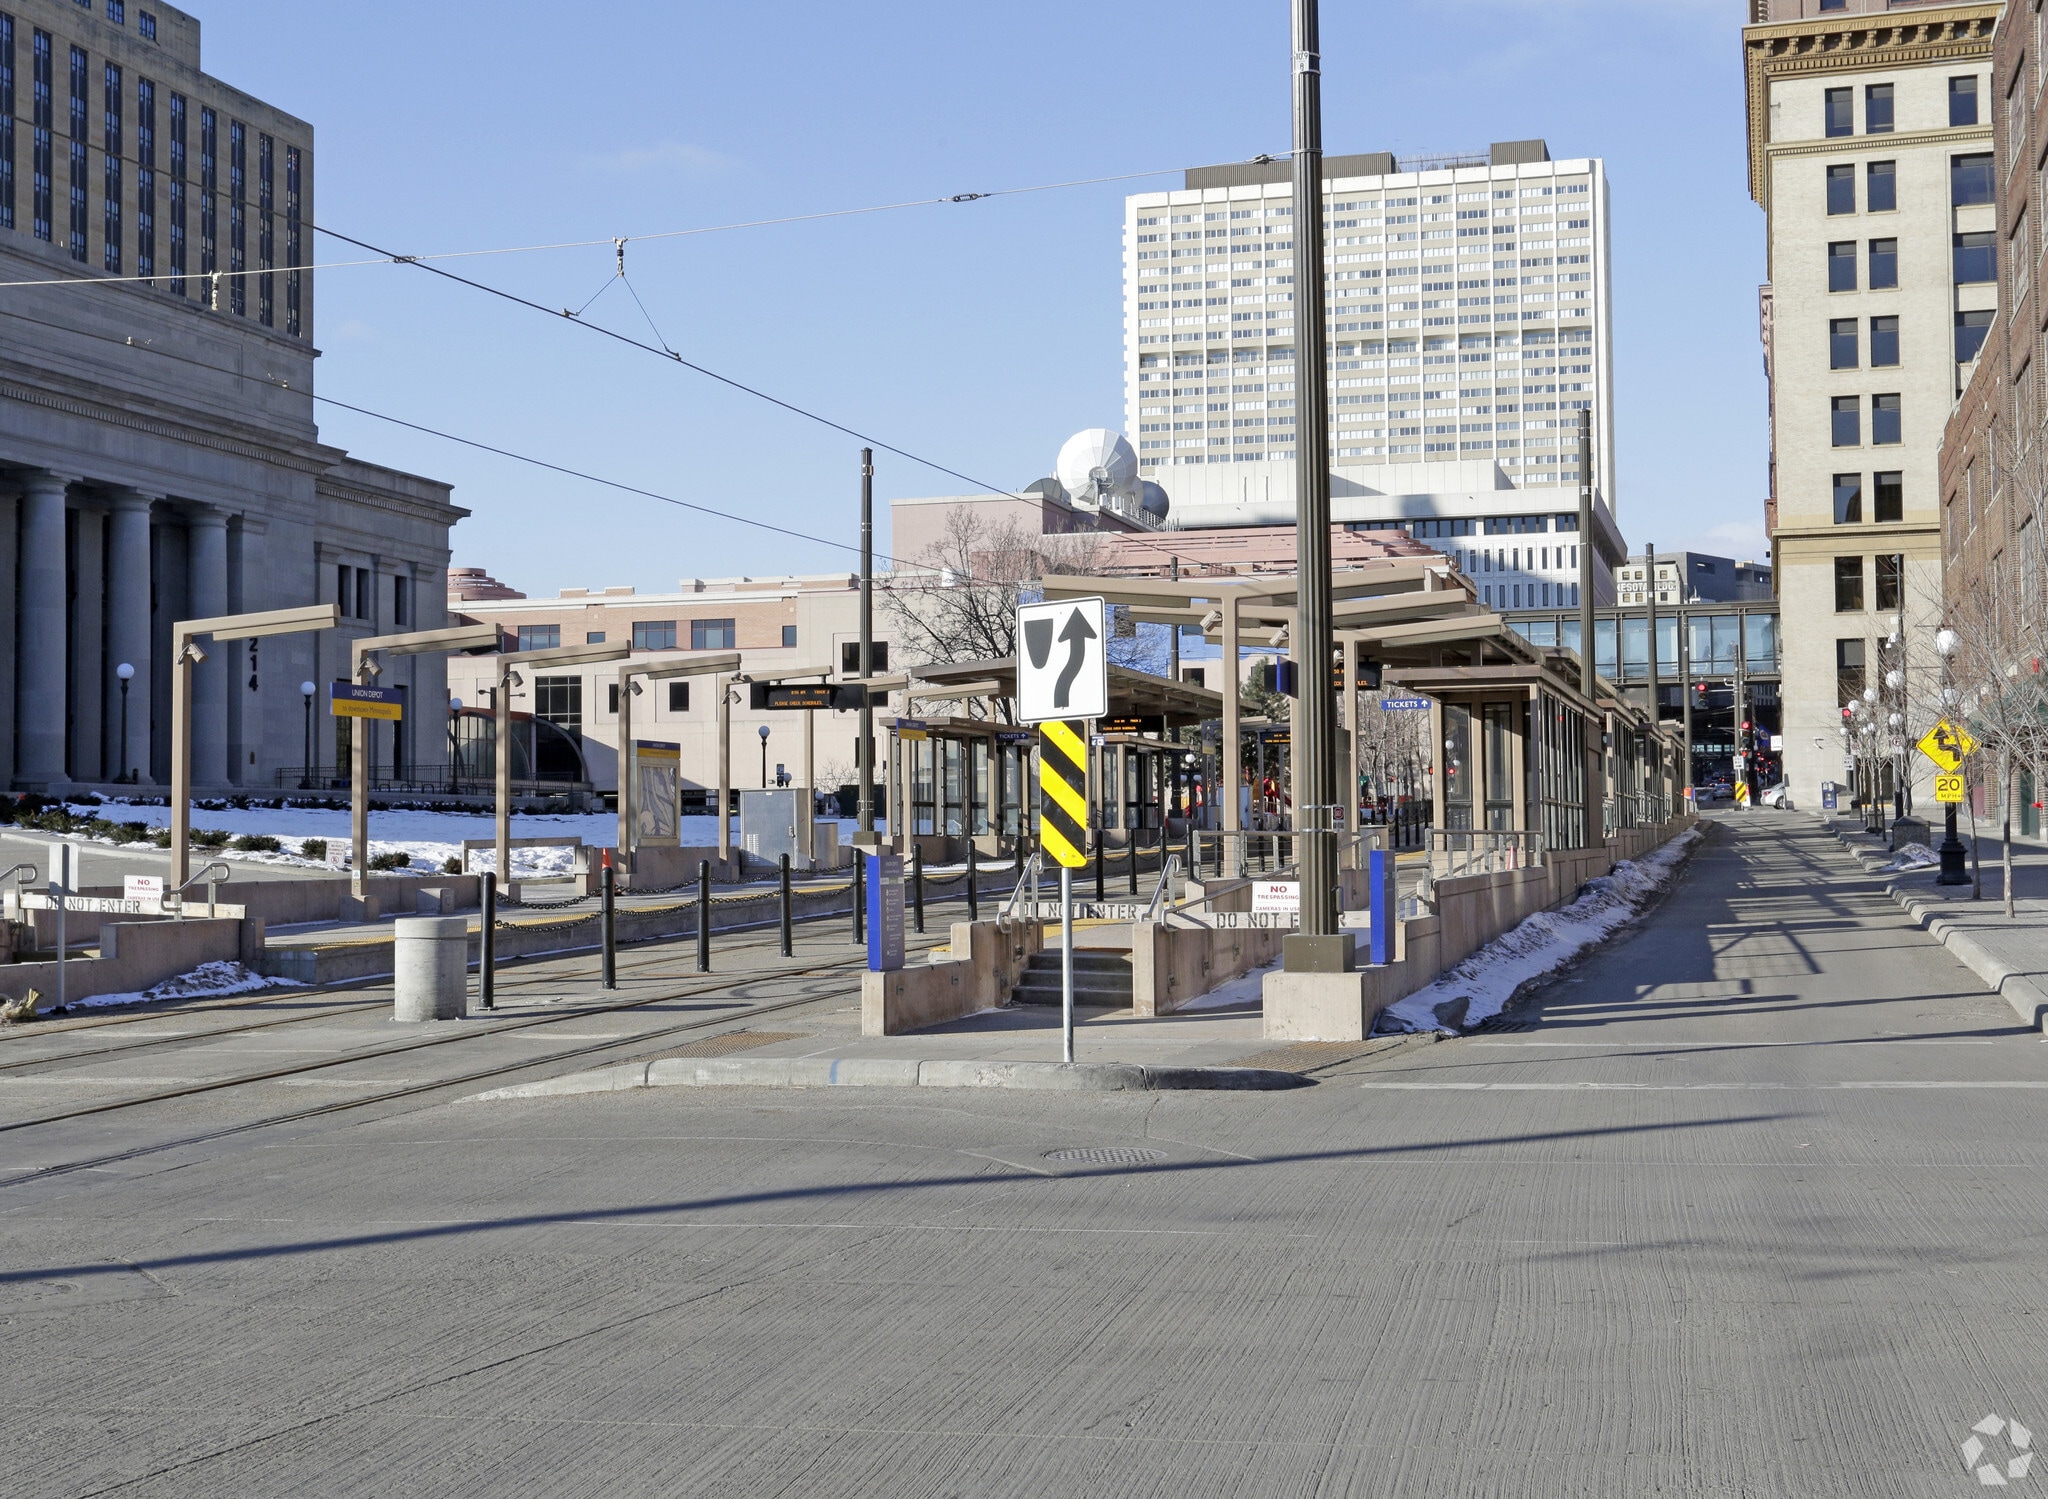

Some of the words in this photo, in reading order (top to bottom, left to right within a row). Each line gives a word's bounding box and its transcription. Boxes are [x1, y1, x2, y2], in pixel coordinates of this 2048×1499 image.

[352, 689, 368, 697] UNION
[368, 690, 383, 699] DEPOT
[1937, 778, 1960, 791] 20
[1270, 885, 1287, 893] NO
[69, 898, 92, 911] NOT
[100, 899, 141, 913] ENTER
[1216, 912, 1238, 928] DO
[1248, 912, 1280, 928] NOT
